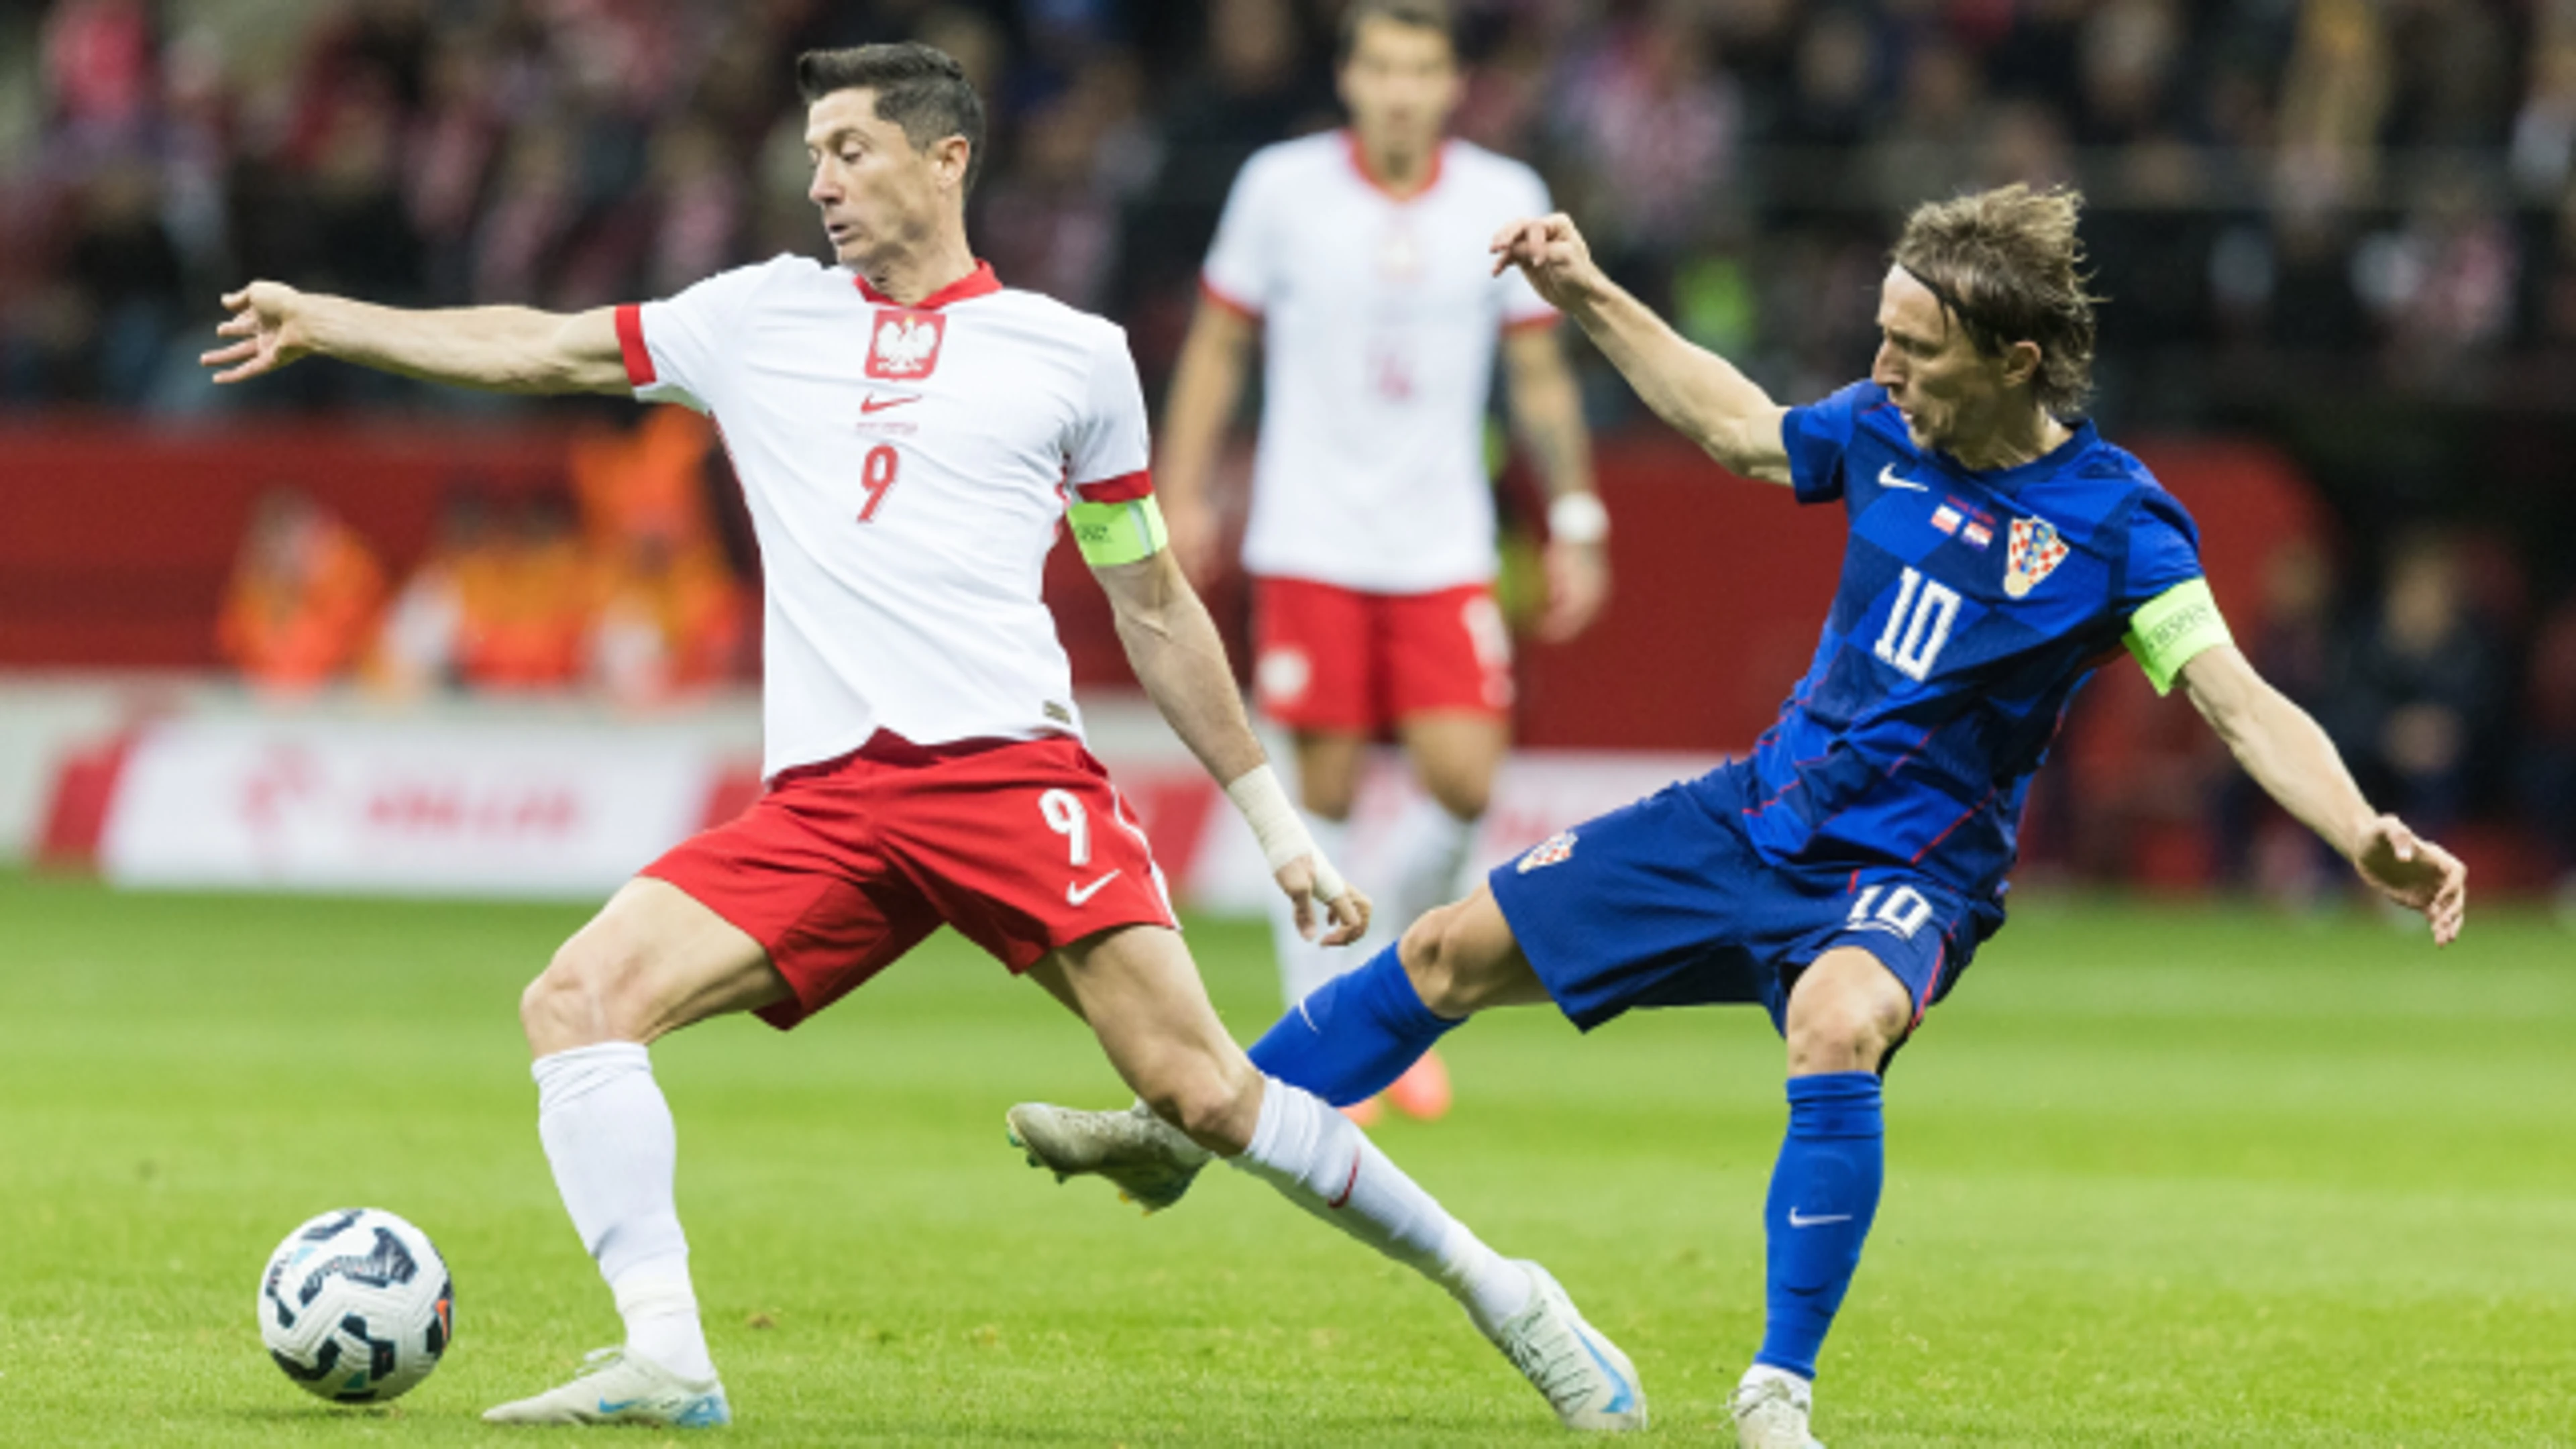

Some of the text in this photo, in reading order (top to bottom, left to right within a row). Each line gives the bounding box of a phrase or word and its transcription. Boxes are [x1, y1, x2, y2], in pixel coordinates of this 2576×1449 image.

[857, 444, 899, 523] 9
[1874, 565, 1962, 682] 10
[1038, 788, 1091, 866] 9
[1845, 885, 1933, 939] 10
